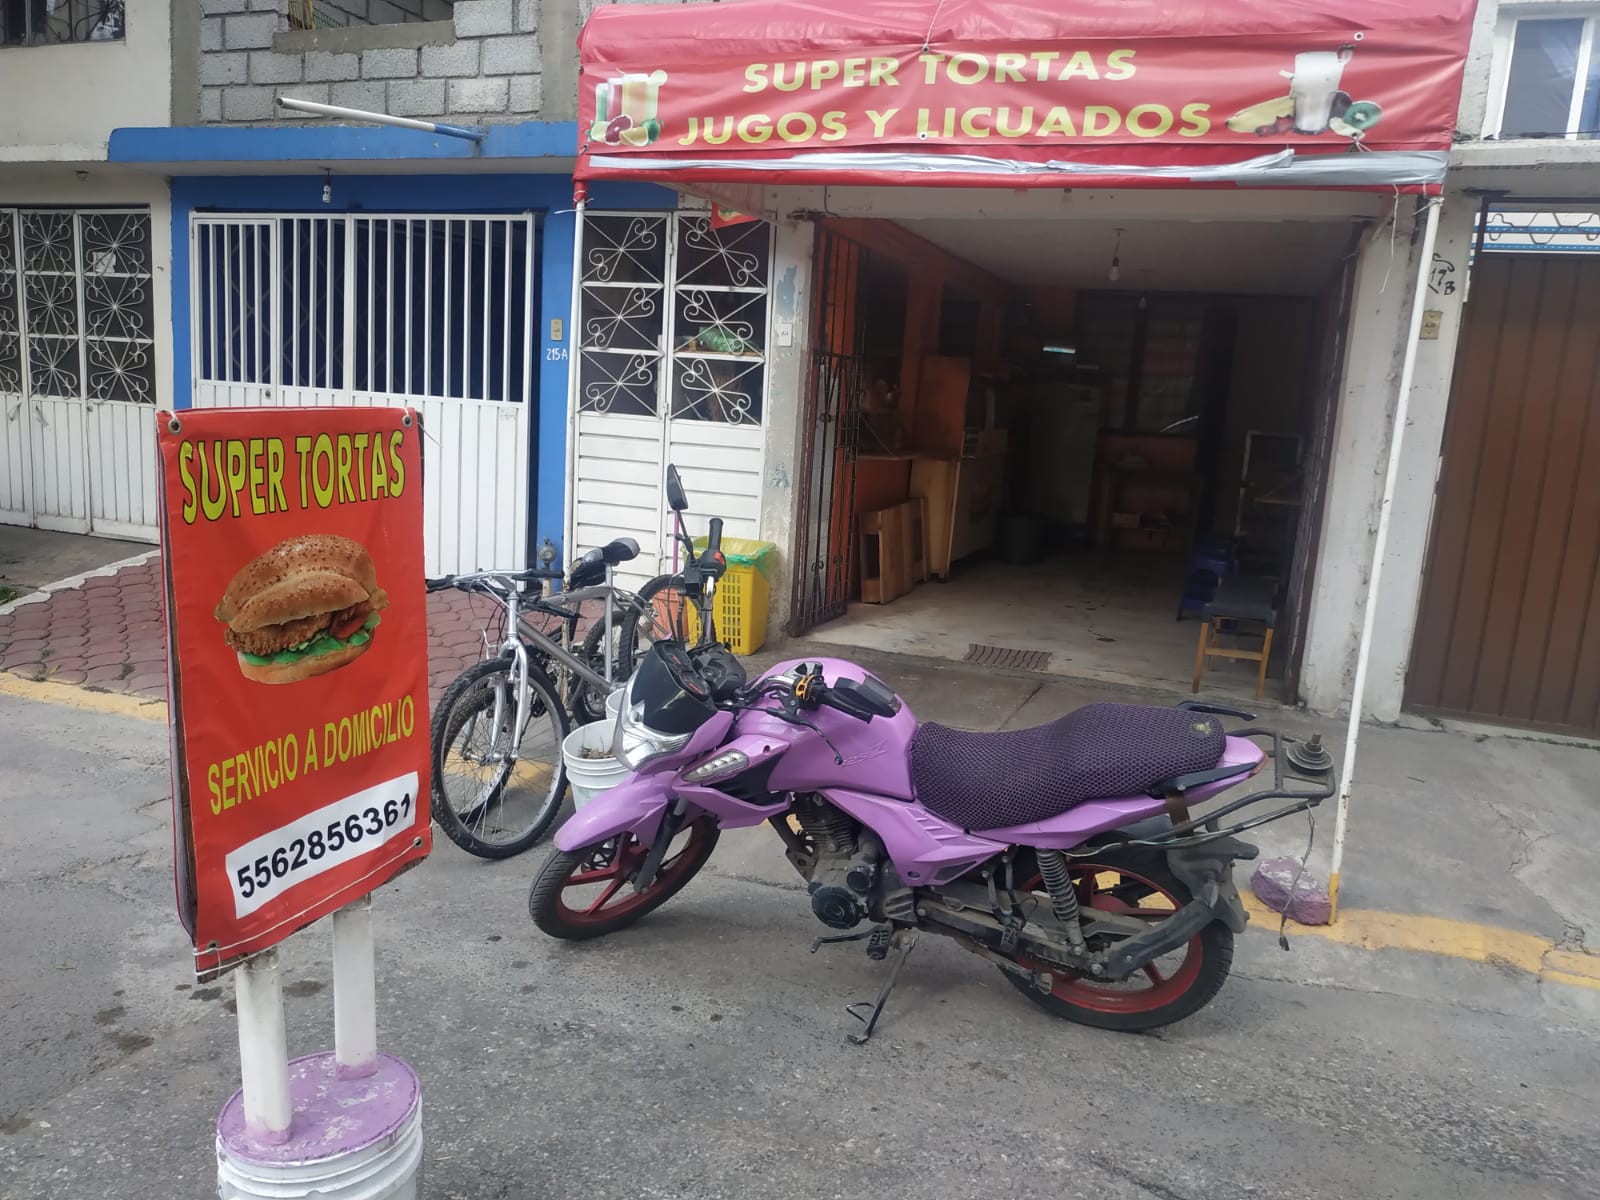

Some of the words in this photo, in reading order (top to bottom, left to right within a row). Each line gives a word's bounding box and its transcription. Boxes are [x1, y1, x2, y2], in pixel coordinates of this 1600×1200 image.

[743, 57, 899, 93] SUPER
[918, 49, 1137, 85] TORTAS
[678, 110, 849, 146] JUGOS
[866, 108, 899, 138] Y
[917, 103, 1211, 138] LICUADOS
[179, 437, 289, 525] SUPER
[295, 430, 406, 509] TORTAS
[207, 733, 299, 816] SERVICIO
[303, 727, 319, 775] A
[323, 694, 415, 768] DOMICILIO
[236, 792, 411, 898] 5562856361
